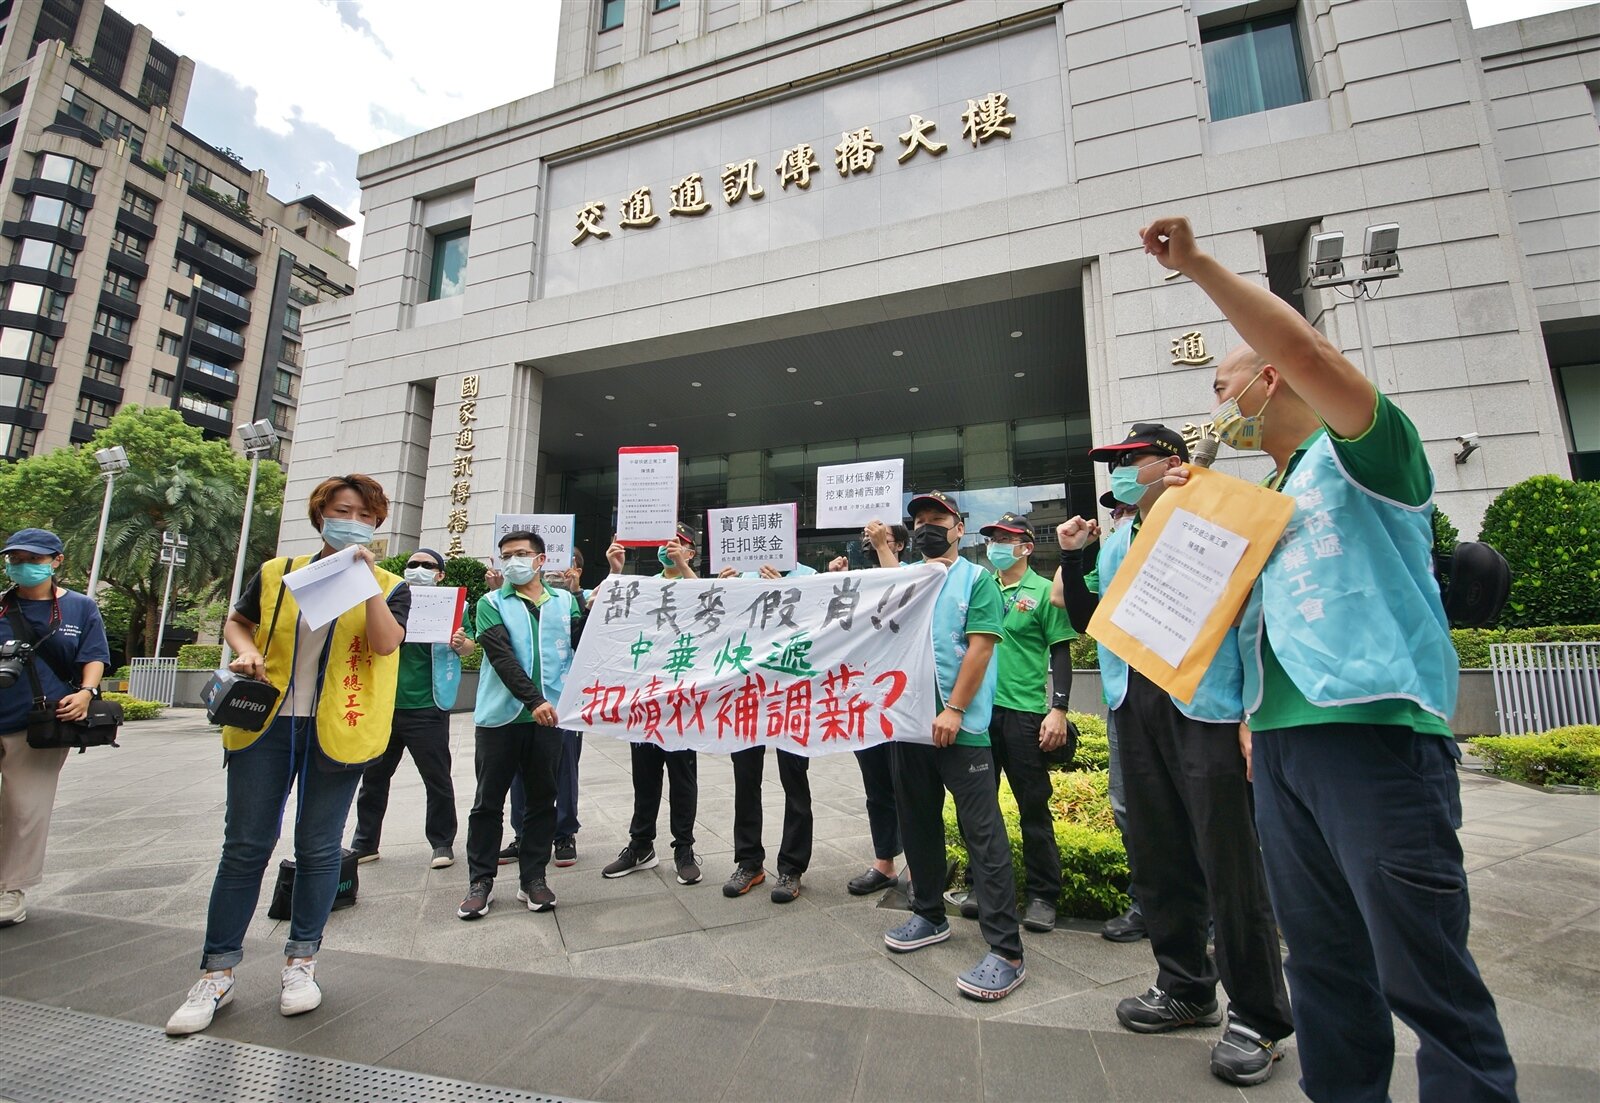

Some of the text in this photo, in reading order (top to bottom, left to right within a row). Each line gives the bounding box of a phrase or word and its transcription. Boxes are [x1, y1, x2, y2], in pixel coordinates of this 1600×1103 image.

[570, 91, 1017, 246] 交通通訊傳播大樓
[1164, 270, 1222, 453] 通部
[444, 373, 480, 561] 國家通訊傳播委
[826, 469, 895, 485] 王國材低薪解方
[542, 524, 567, 534] 5,000
[720, 512, 783, 533] 實質調薪
[544, 543, 565, 552] 能減
[720, 534, 783, 554] 拒扣獎金
[629, 630, 825, 682] 中華快遞
[341, 635, 365, 727] 產業總工會
[229, 698, 267, 713] MIPRO
[580, 662, 909, 748] 扣績效補調薪?
